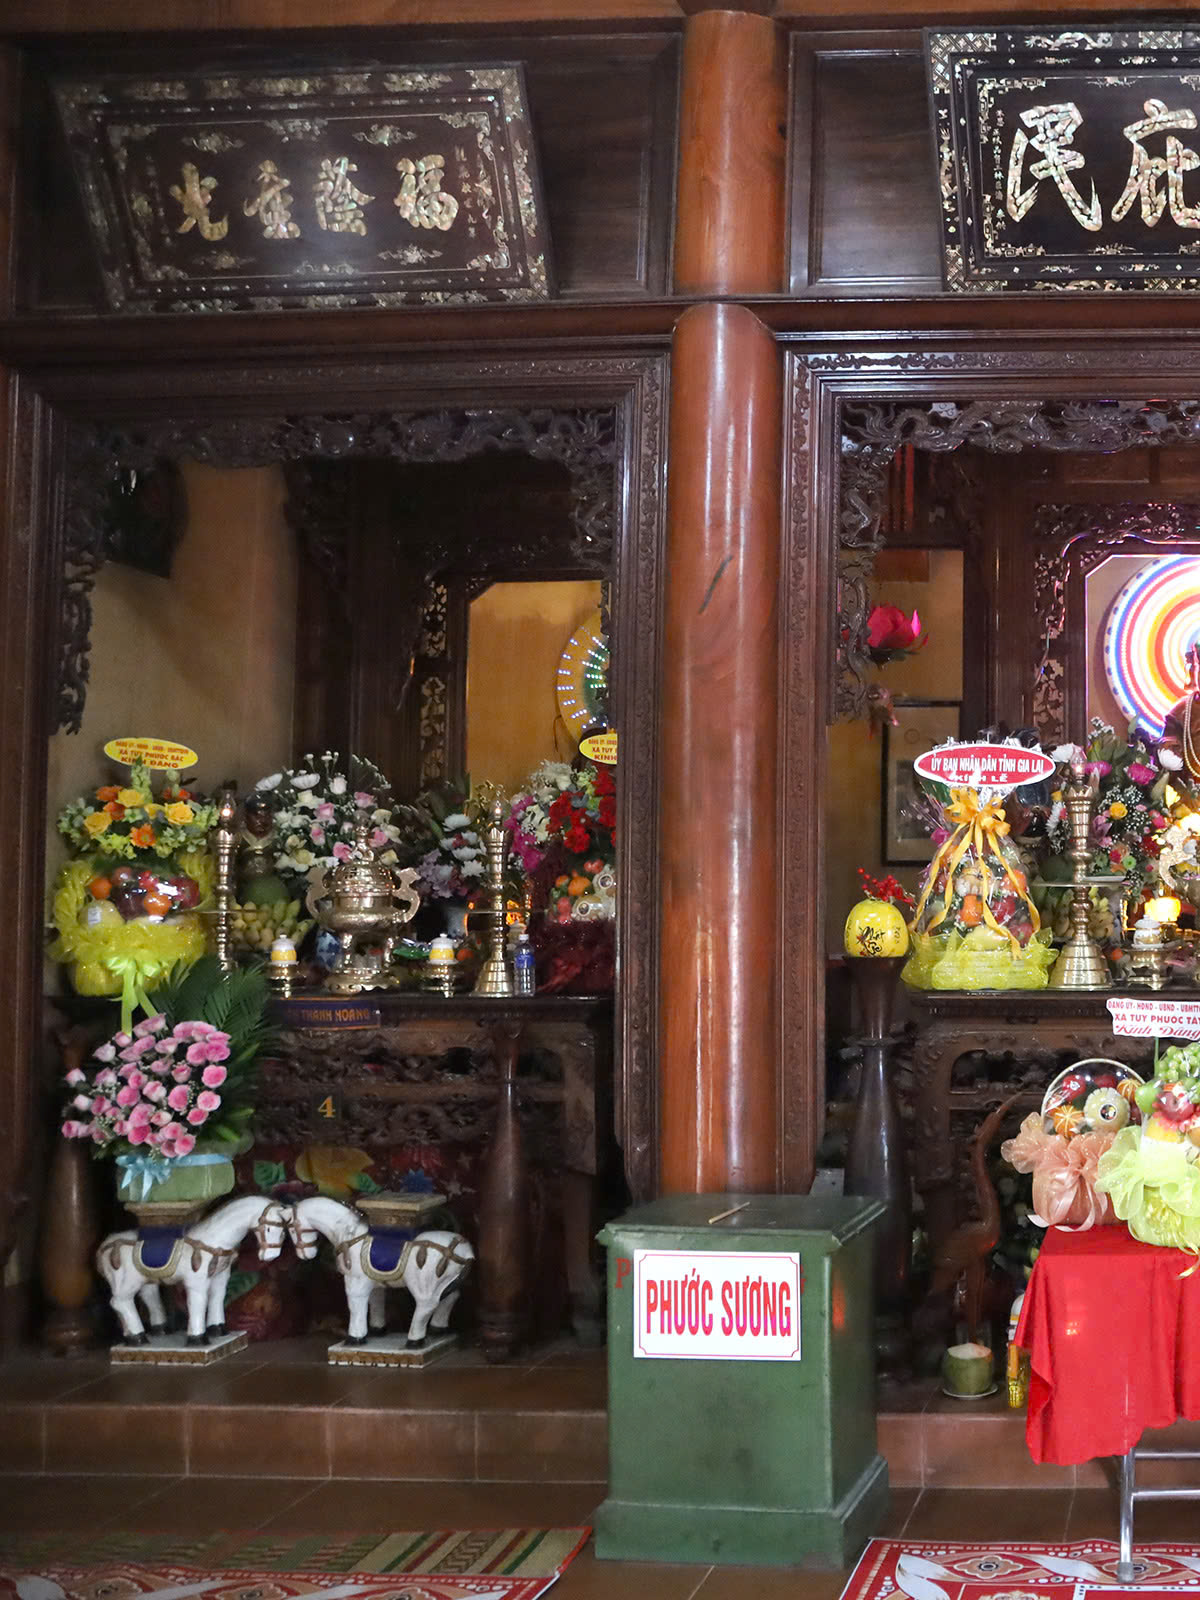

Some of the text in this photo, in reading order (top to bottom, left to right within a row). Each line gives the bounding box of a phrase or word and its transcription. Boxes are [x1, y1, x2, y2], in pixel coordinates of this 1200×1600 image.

[943, 758, 958, 771] BAN
[960, 755, 980, 771] NHÂN
[981, 755, 997, 772] DÂN
[1017, 758, 1030, 773] GIA
[1031, 759, 1044, 773] LAI
[1130, 1014, 1148, 1022] TUY
[318, 1096, 336, 1118] 4
[646, 1267, 791, 1337] PHƯỚC SƯƠNG
